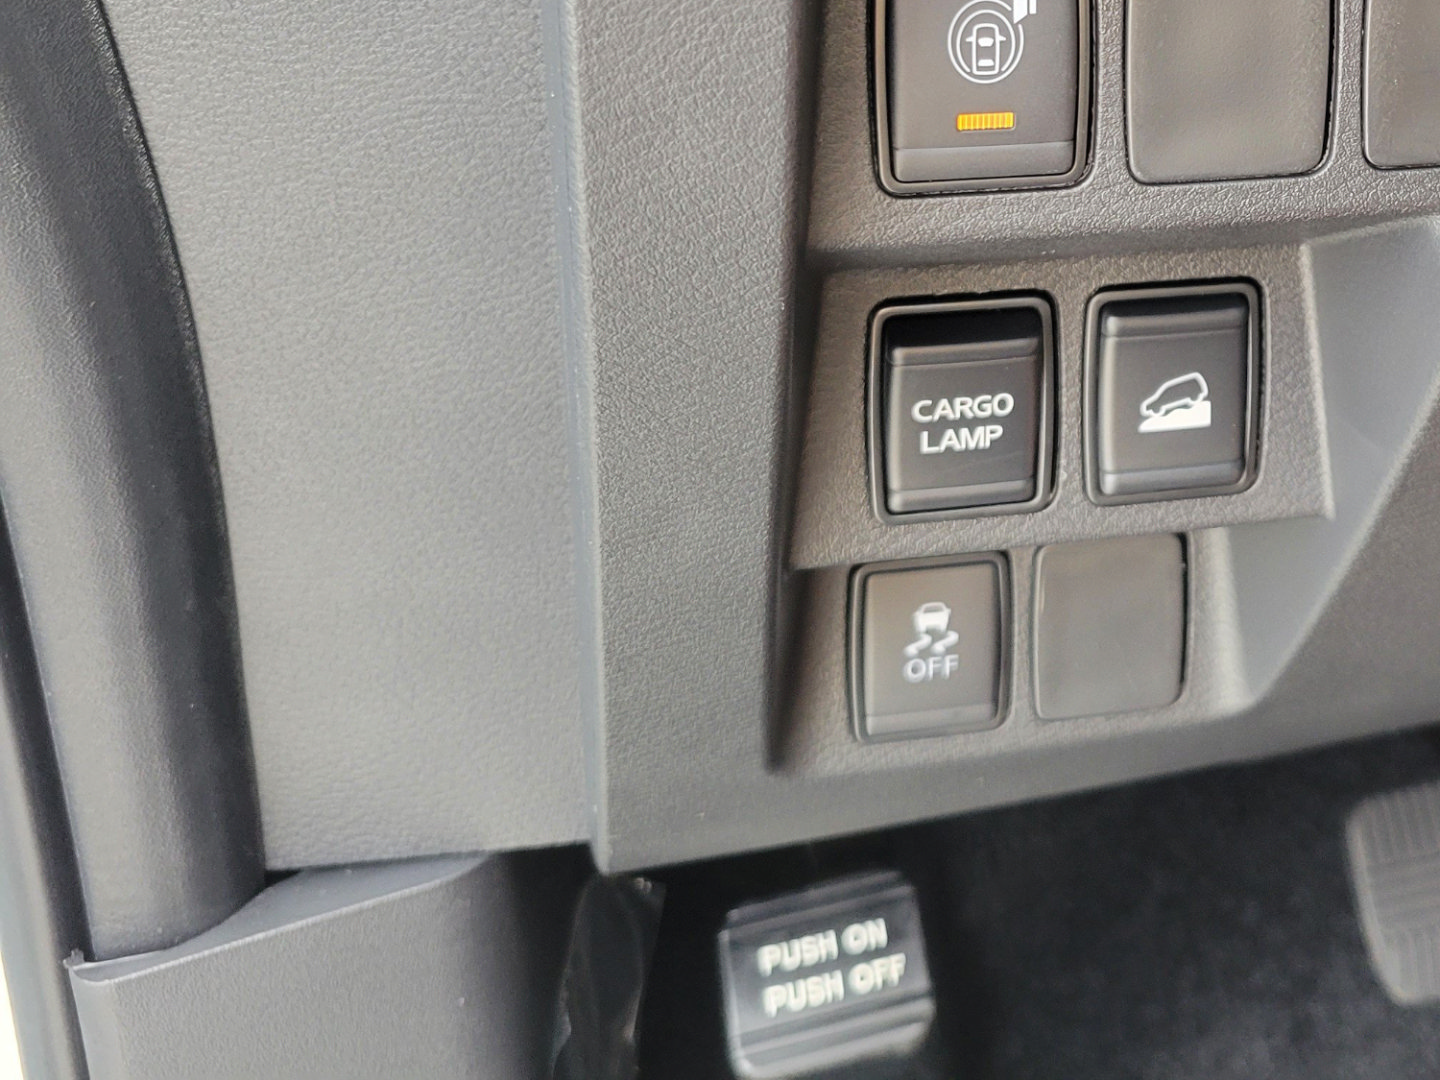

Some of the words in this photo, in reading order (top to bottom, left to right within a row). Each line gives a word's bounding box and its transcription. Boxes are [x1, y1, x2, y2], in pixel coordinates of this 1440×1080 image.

[911, 392, 1014, 422] CARGO
[919, 424, 1003, 454] LAMP
[903, 654, 959, 683] OFF
[757, 928, 839, 977] PUSH
[841, 917, 888, 956] ON
[762, 969, 845, 1018] PUSH
[848, 952, 906, 996] OFF
